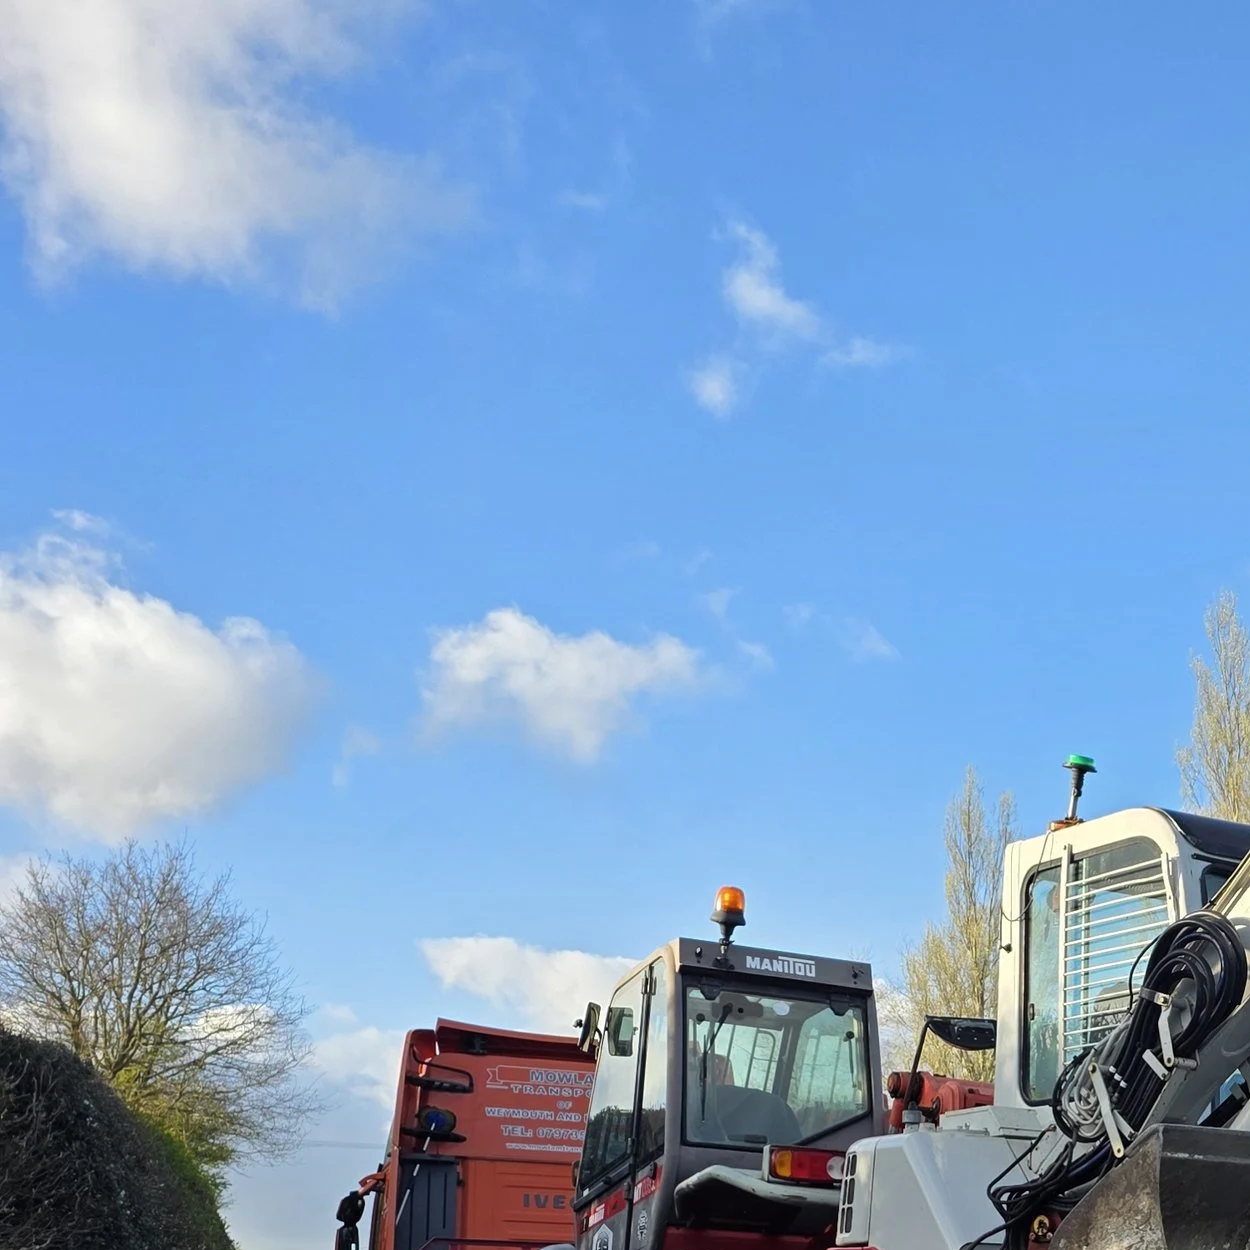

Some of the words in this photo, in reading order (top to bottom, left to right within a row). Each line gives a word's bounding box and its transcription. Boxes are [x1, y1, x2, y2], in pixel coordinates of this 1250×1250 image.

[746, 955, 816, 977] MANITOU
[556, 1101, 572, 1110] OF
[485, 1106, 554, 1121] WEYMOUTH
[556, 1112, 582, 1123] AND
[500, 1124, 533, 1137] TEL:
